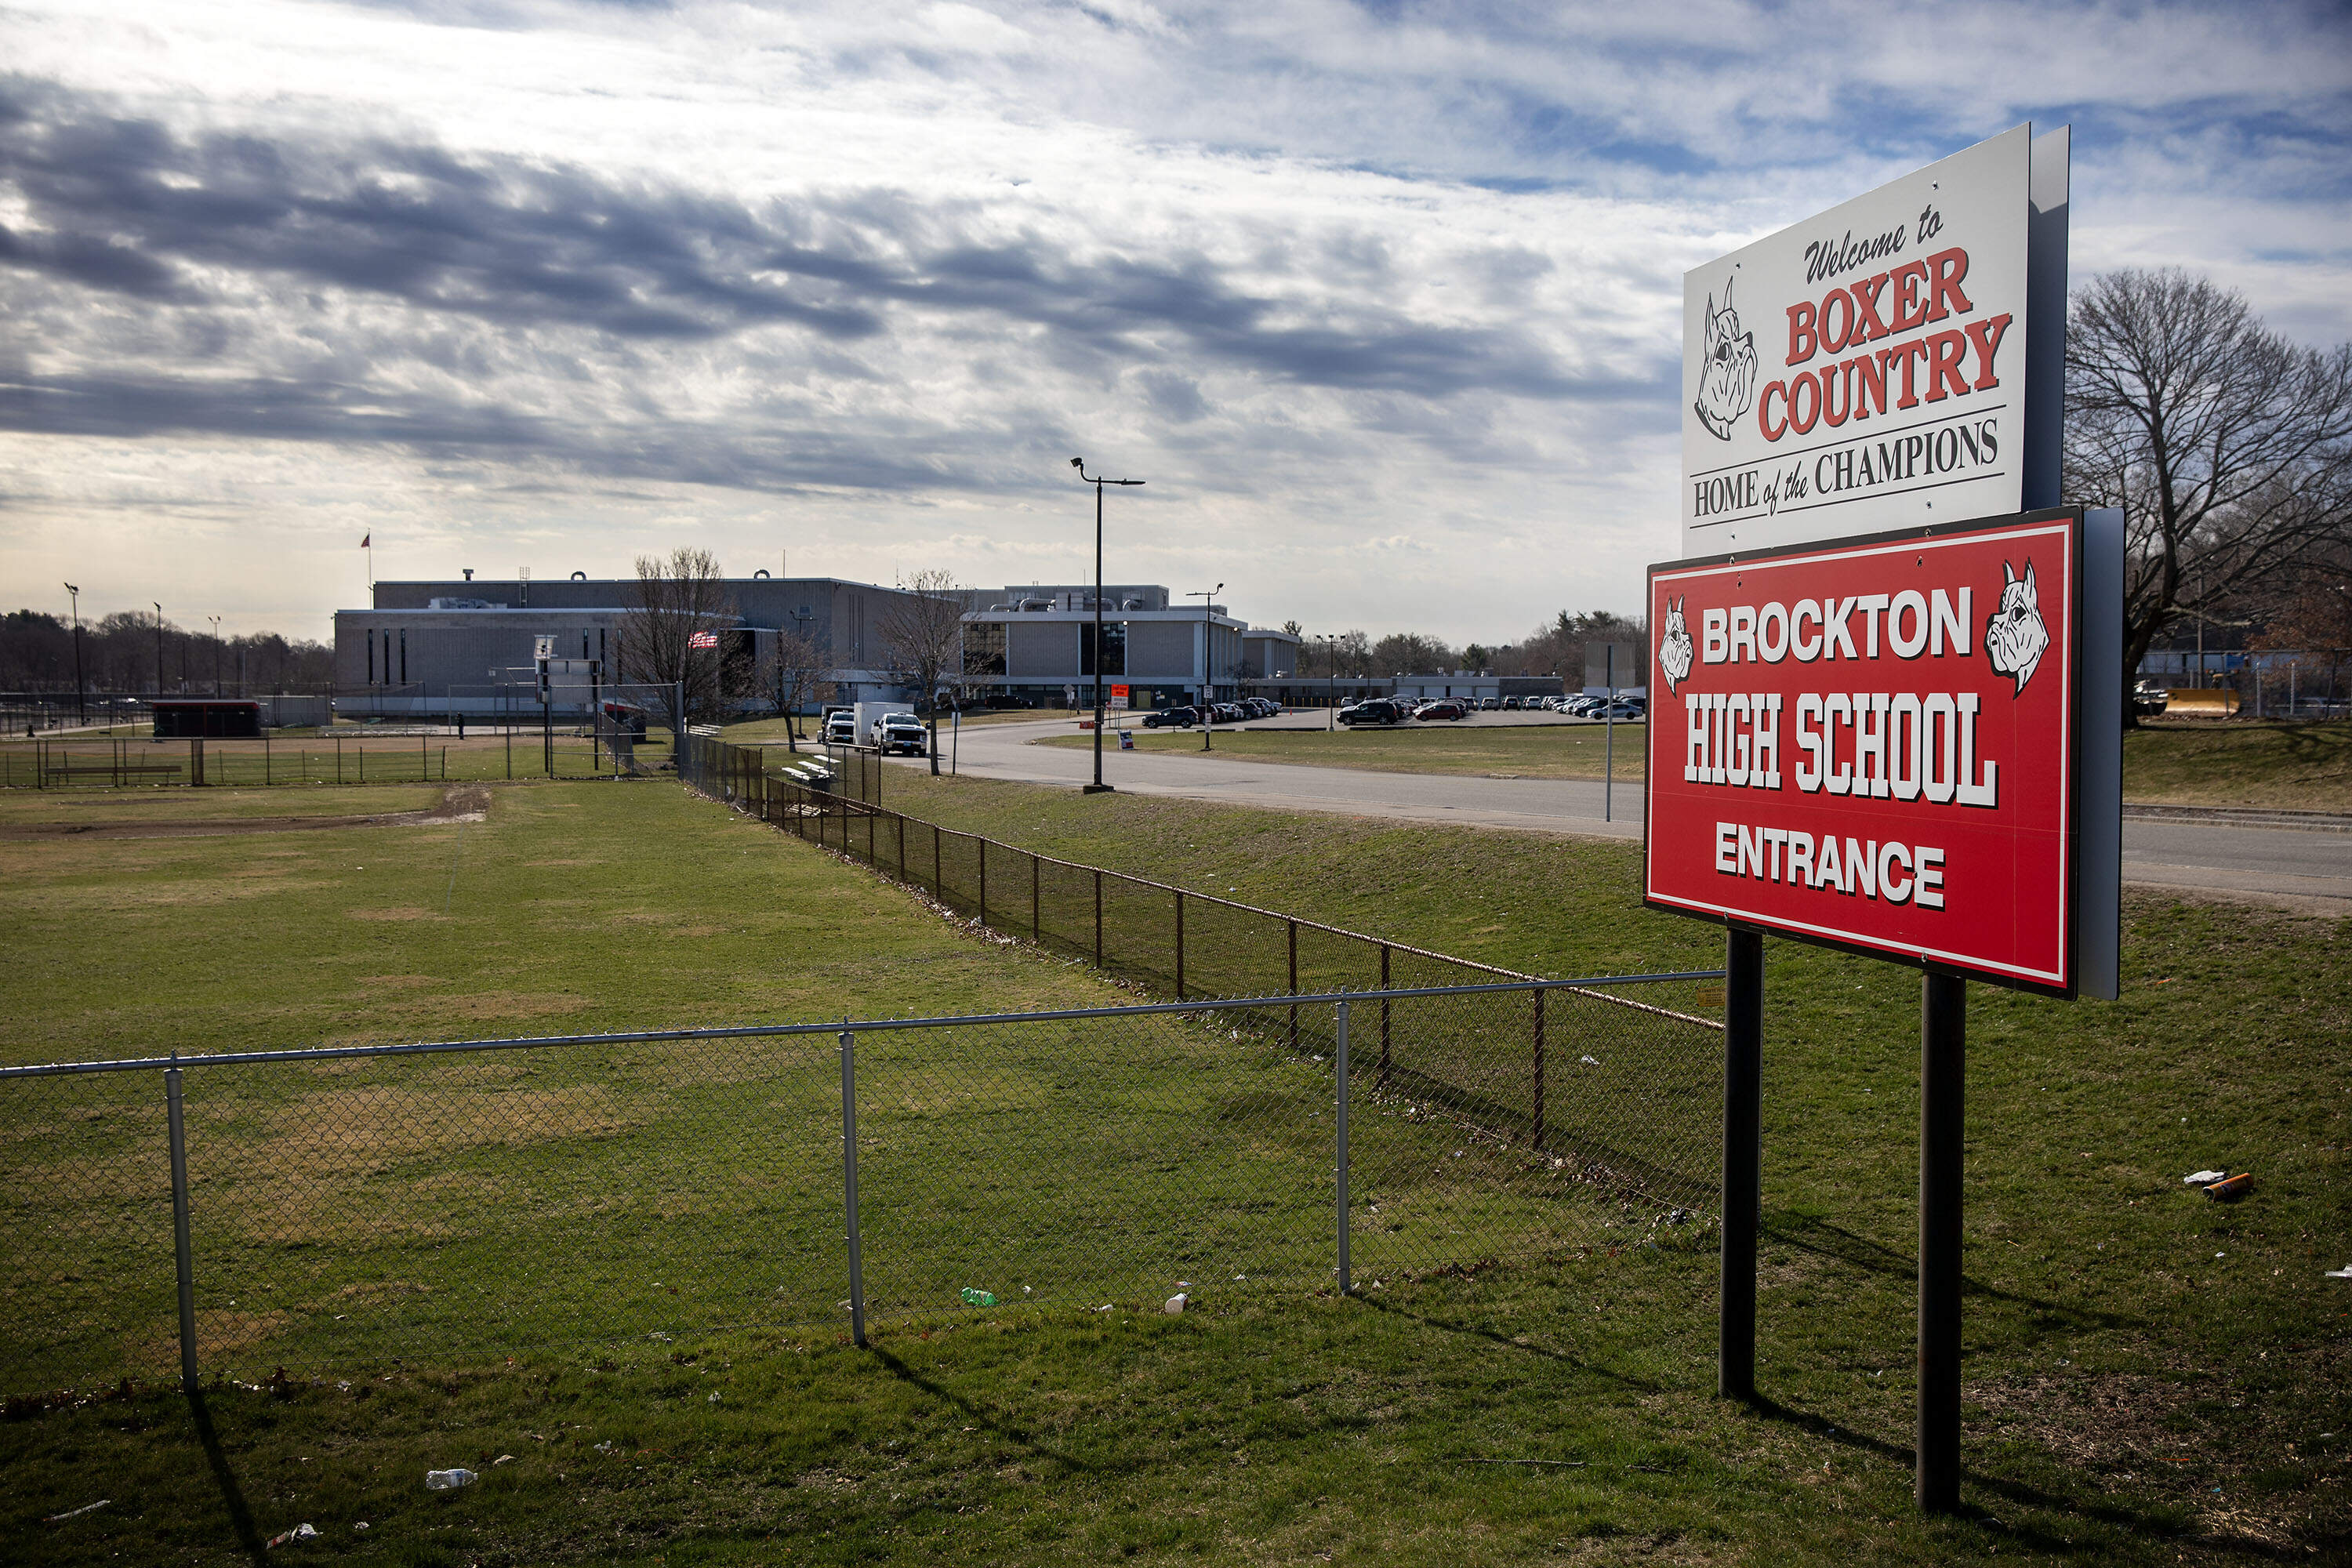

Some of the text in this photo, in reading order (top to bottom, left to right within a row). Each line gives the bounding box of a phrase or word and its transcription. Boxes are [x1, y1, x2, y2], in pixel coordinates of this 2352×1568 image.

[1805, 205, 1943, 284] Welcome to
[1786, 248, 1973, 367] BOXER
[1759, 313, 2013, 442] COUNTRY
[1694, 418, 1997, 517] HOME of the CHAMPIONS
[1703, 586, 1970, 662] BROCKTON
[1685, 693, 1995, 806] HIGH SCHOOL
[1716, 822, 1944, 907] ENTRANCE
